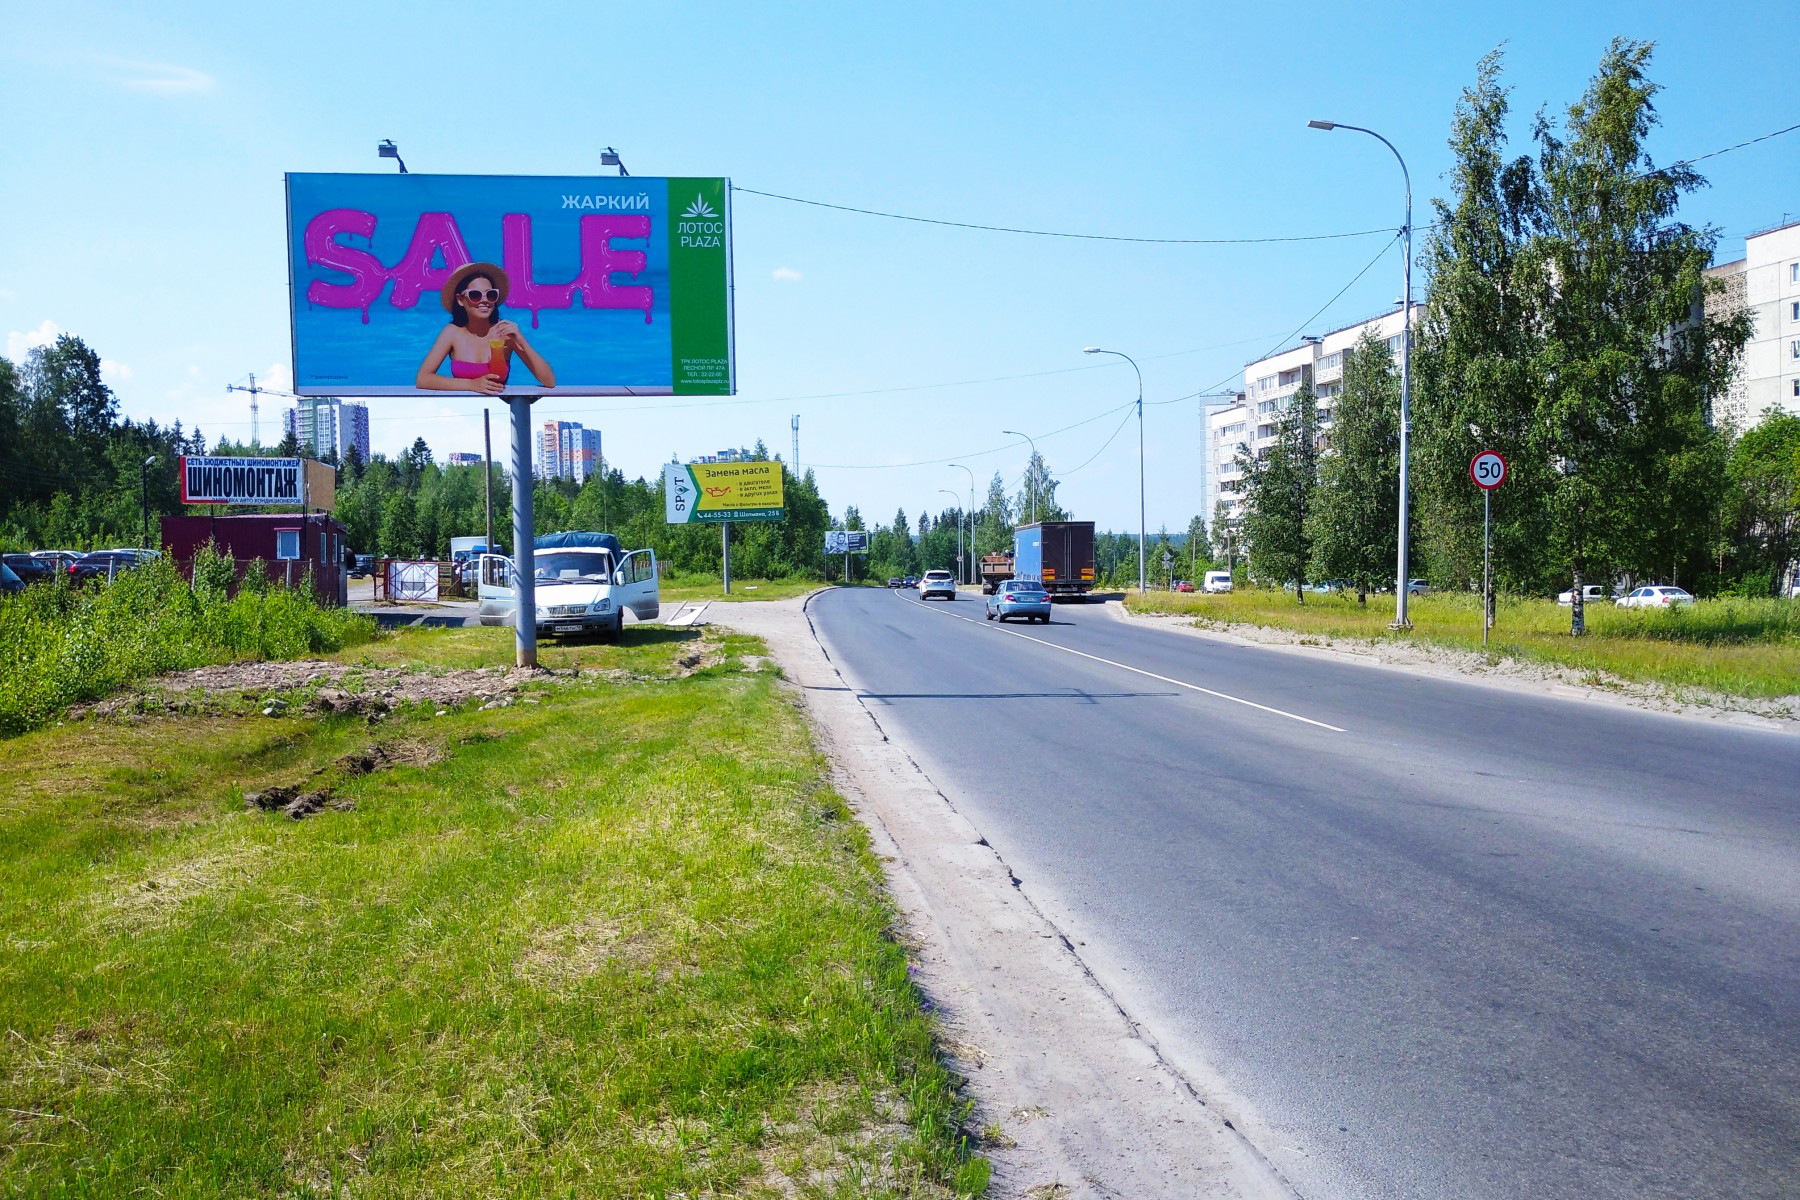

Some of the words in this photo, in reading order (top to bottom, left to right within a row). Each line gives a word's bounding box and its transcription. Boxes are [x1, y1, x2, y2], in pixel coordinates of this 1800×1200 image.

[561, 192, 650, 210] ЖАРКИЙ
[677, 222, 723, 234] ЛОТОС
[681, 236, 720, 248] PLAZA
[304, 207, 654, 325] SALE
[187, 458, 202, 466] СЕТЬ
[204, 459, 245, 467] БЮДЖЕТНЫХ
[247, 459, 300, 468] ШИНОМОНТАЖЕЙ
[1479, 462, 1501, 479] 50
[705, 468, 740, 478] Замена
[742, 467, 770, 476] масла
[187, 467, 298, 498] ШИНОМОНТАЖ
[674, 477, 687, 512] SPOT
